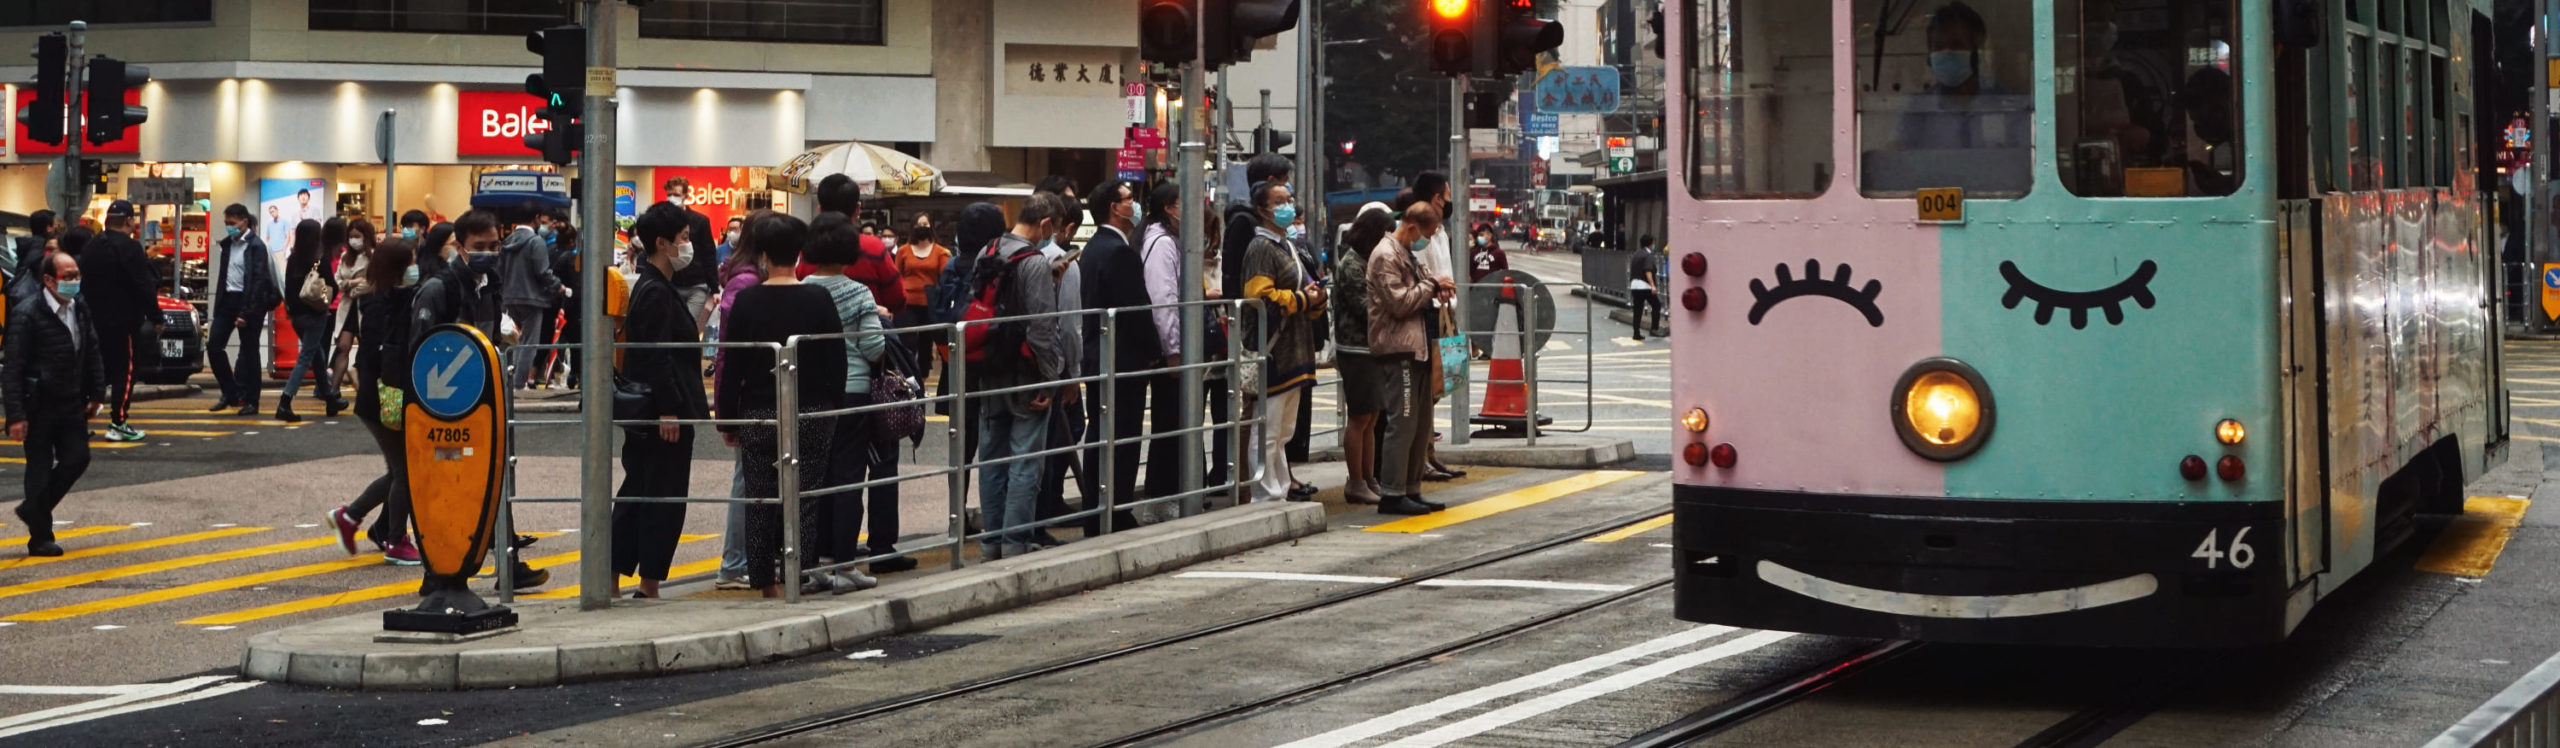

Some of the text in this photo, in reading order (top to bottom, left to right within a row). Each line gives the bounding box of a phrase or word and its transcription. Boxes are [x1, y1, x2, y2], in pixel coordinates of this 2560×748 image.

[1922, 193, 1956, 213] 004
[183, 235, 190, 247] $
[427, 427, 471, 442] 47805
[2191, 526, 2255, 569] 46
